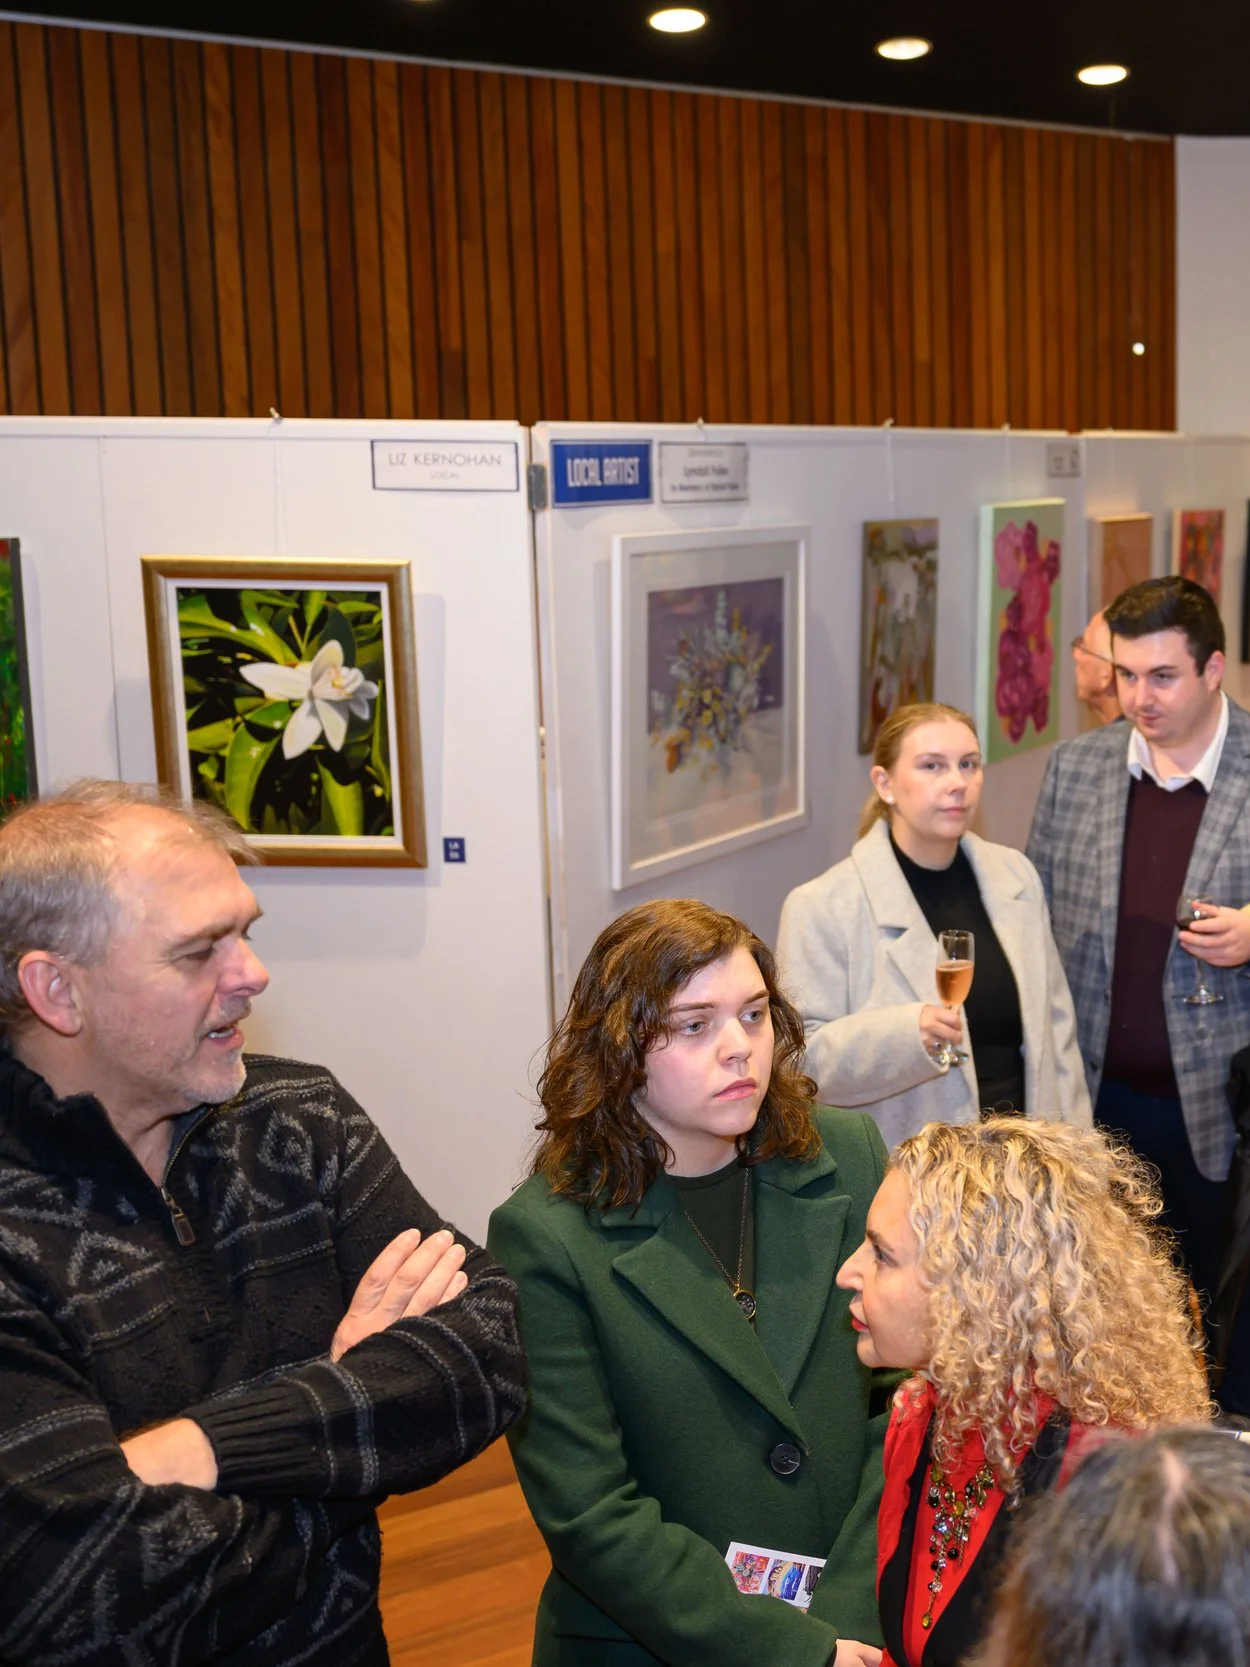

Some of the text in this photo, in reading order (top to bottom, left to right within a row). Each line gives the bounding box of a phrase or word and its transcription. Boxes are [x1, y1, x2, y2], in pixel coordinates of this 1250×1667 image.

[413, 452, 502, 467] KERNOHAN
[566, 456, 641, 488] LOCAL ARTIST
